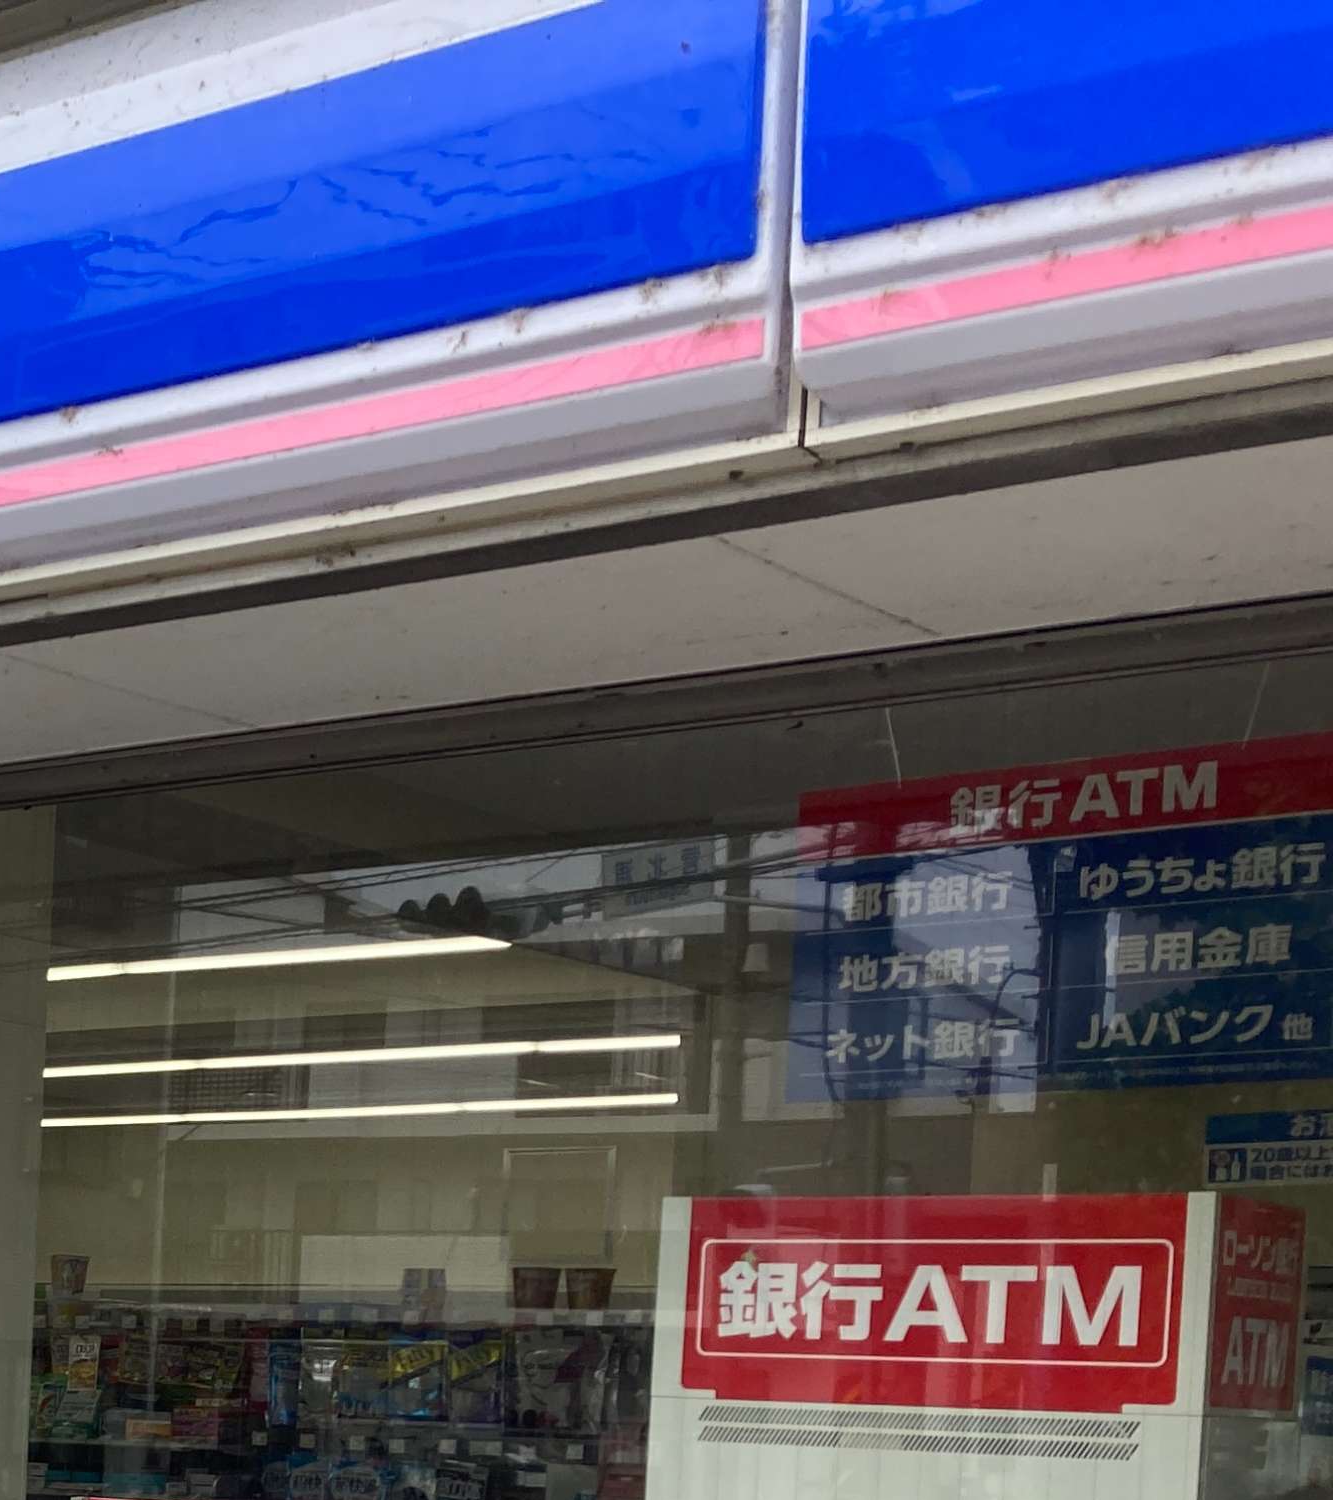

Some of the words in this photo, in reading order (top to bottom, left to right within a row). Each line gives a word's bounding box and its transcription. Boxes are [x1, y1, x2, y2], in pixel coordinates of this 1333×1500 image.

[949, 761, 1219, 837] 銀行ATM
[842, 870, 1014, 922] 都市銀行
[1079, 842, 1326, 900] ゆうちょ銀行
[838, 944, 1012, 994] 地方銀行
[1114, 923, 1293, 974] 信用金庫
[827, 1018, 1021, 1065] ネット銀行
[1077, 1004, 1274, 1051] JAバンク
[1281, 1012, 1315, 1043] 他
[718, 1261, 1144, 1346] 銀行ATM
[1221, 1315, 1290, 1389] ATM
